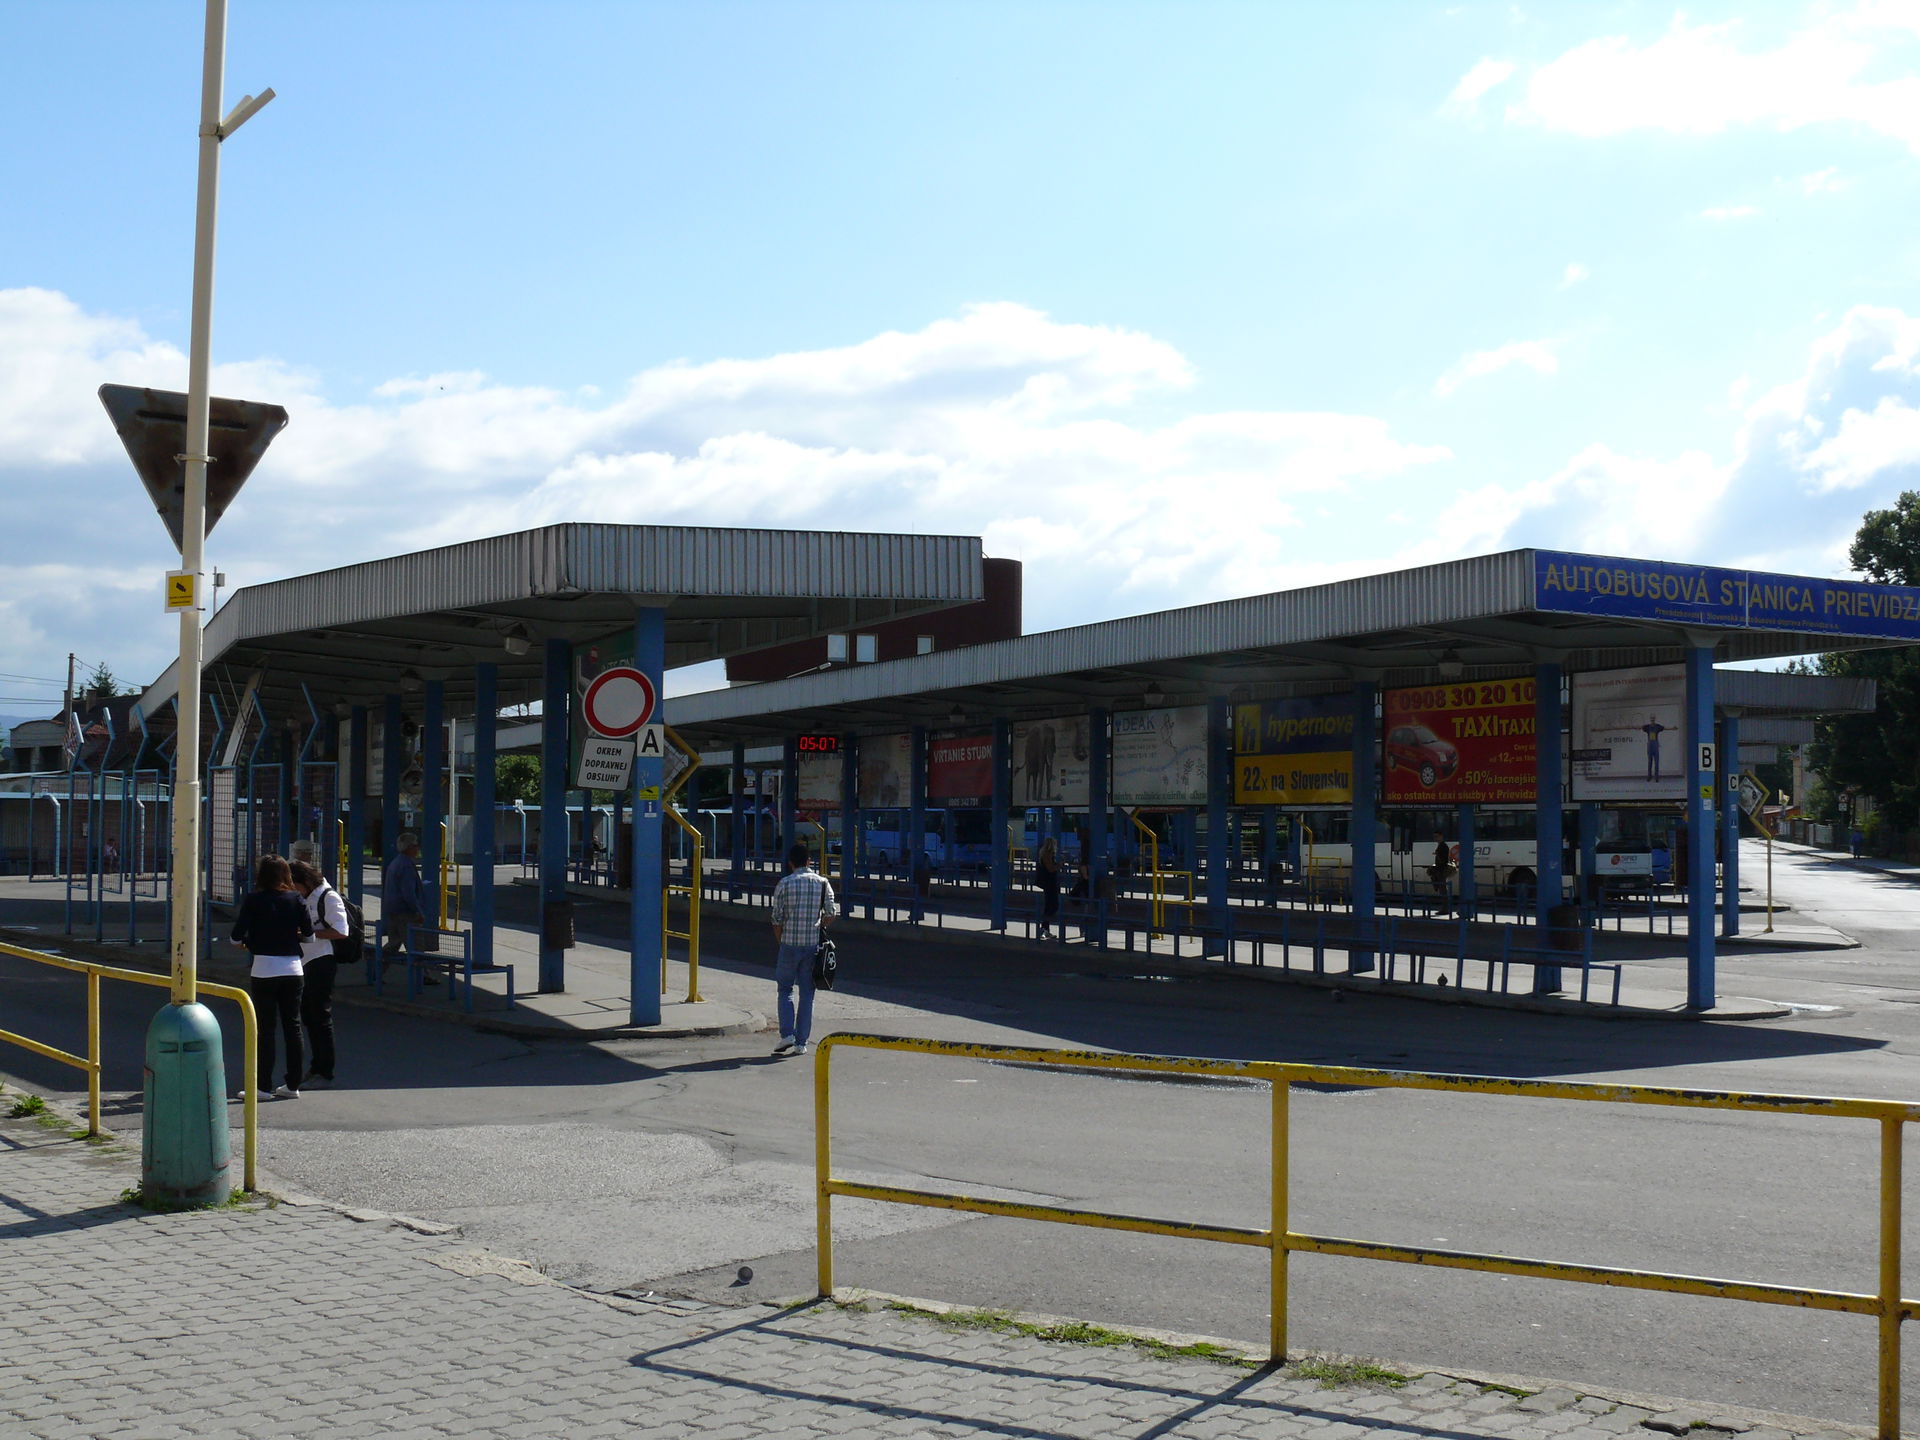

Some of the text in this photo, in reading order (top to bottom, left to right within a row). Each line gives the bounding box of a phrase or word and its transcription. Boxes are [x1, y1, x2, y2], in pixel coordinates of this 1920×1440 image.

[1543, 563, 1711, 603] AUTOBUSOVÁ
[1720, 579, 1815, 613] STANICA
[1399, 681, 1536, 711] 0908 30 20 10
[1267, 713, 1353, 744] hypernova
[641, 728, 659, 753] A
[596, 746, 621, 757] OKREM
[933, 745, 992, 764] VRTANIE STUDN
[1702, 747, 1712, 768] B
[585, 759, 627, 771] DOPRAVNEJ
[586, 772, 620, 783] OBSLUHY
[1271, 773, 1284, 790] na
[1290, 768, 1348, 791] Slovensku
[1465, 770, 1492, 785] 50%
[1730, 776, 1737, 789] C
